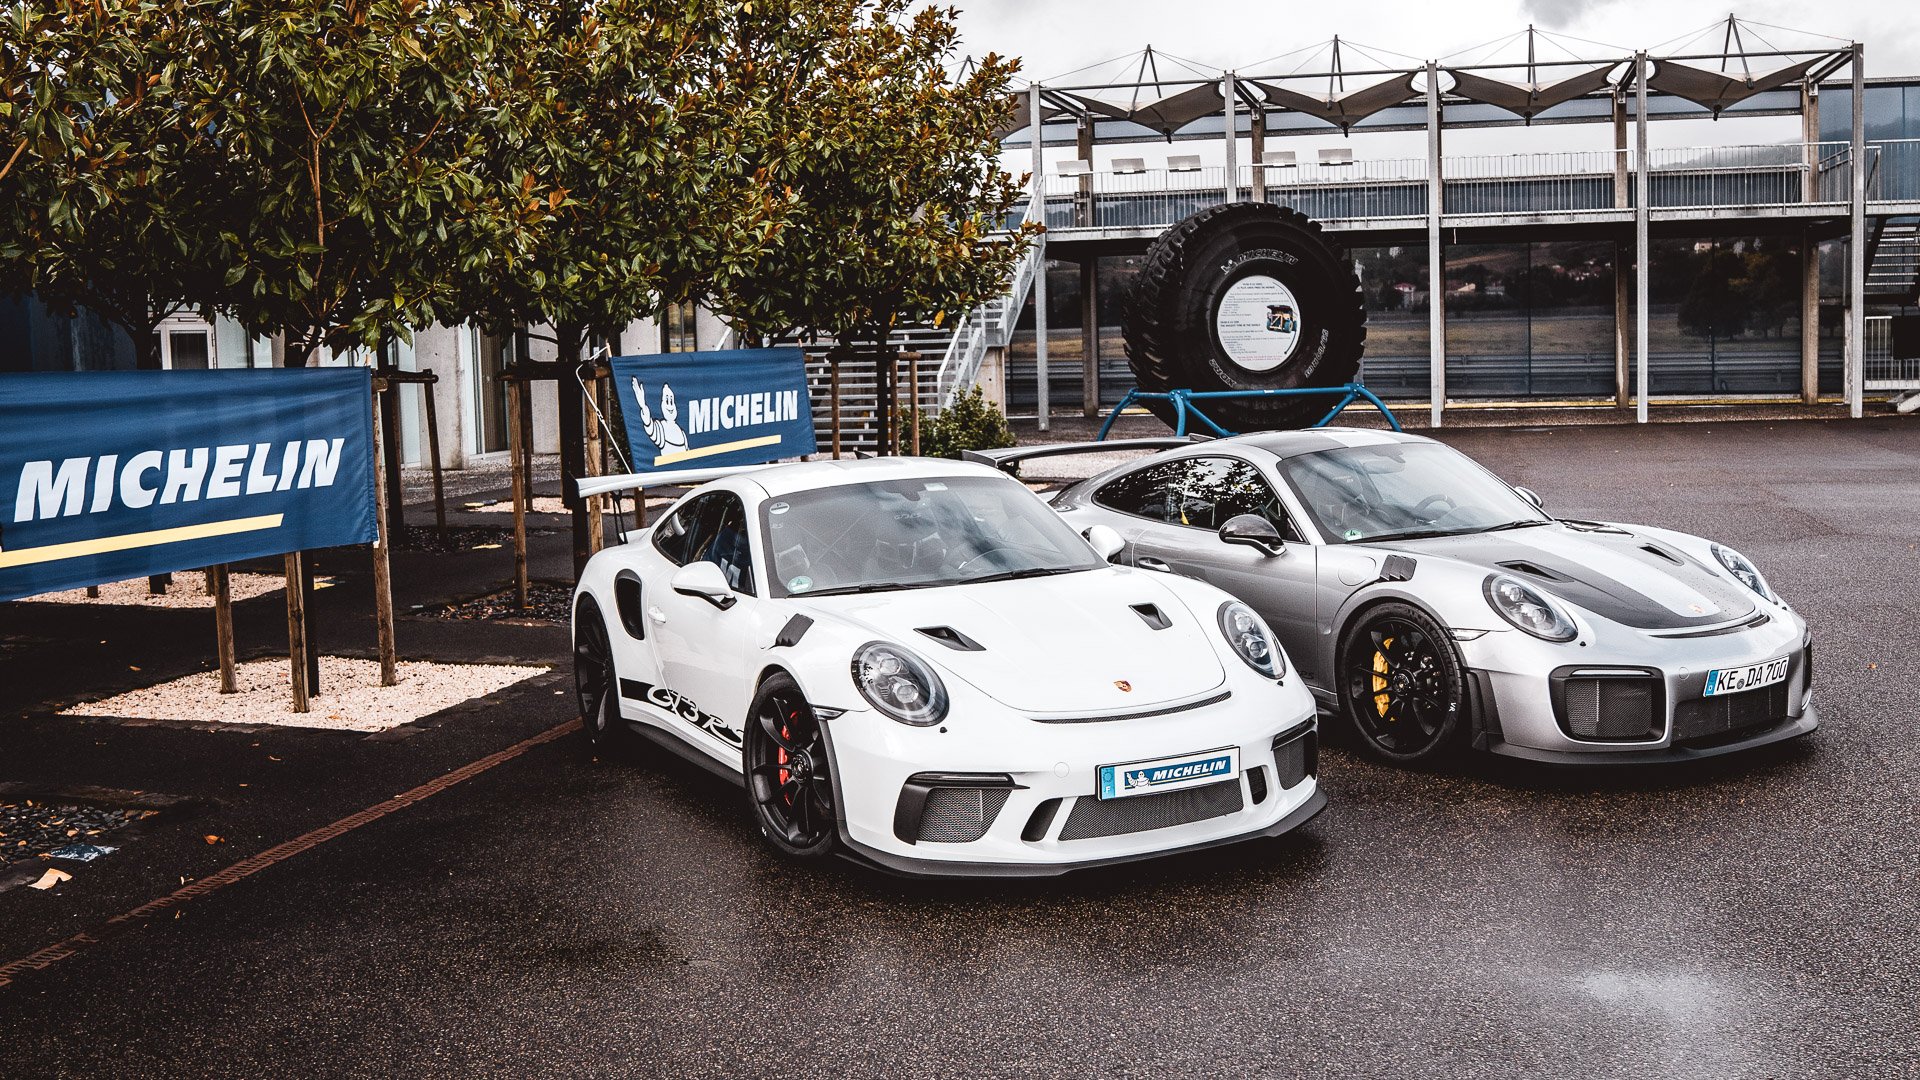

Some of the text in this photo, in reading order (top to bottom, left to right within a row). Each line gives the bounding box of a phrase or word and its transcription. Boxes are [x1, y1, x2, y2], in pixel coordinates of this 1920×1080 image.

[1238, 249, 1299, 265] MICHELIN
[688, 390, 798, 435] MICHELIN
[14, 437, 345, 523] MICHELIN
[1717, 659, 1787, 691] KE DA 700
[647, 686, 700, 722] GT3
[1152, 759, 1227, 781] MICHELIN
